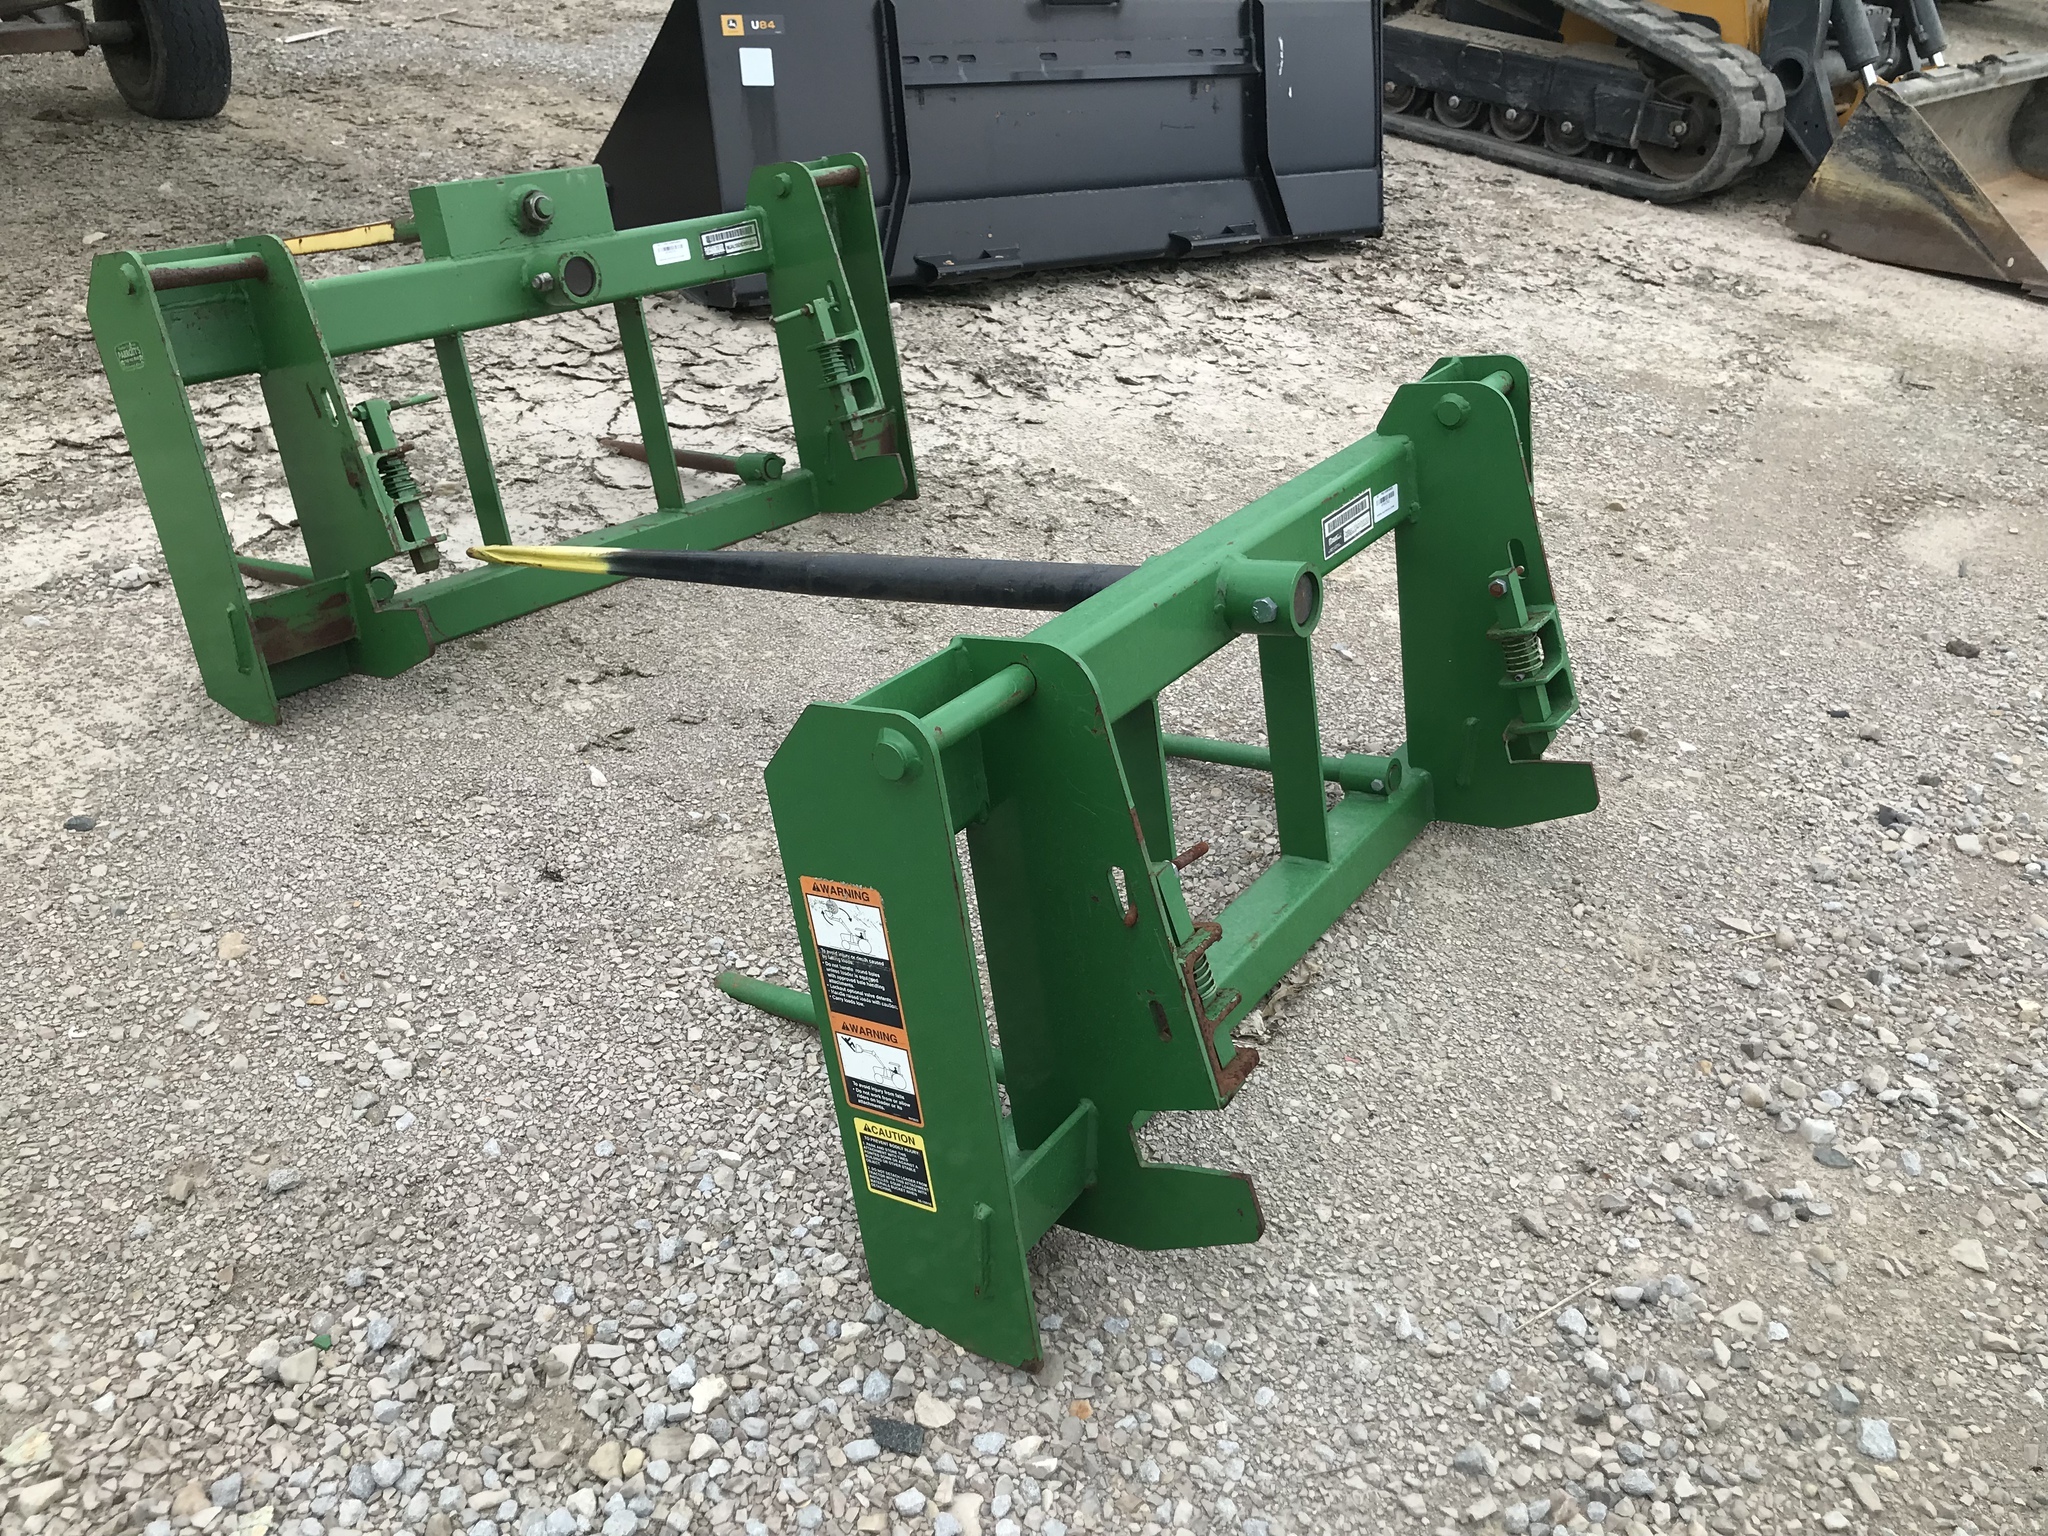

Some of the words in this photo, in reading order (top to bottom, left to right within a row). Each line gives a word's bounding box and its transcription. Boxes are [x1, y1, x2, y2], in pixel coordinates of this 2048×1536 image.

[750, 20, 776, 30] U84
[820, 884, 870, 902] WARNING
[848, 1024, 898, 1044] WARNING
[872, 1126, 916, 1146] CAUTION
